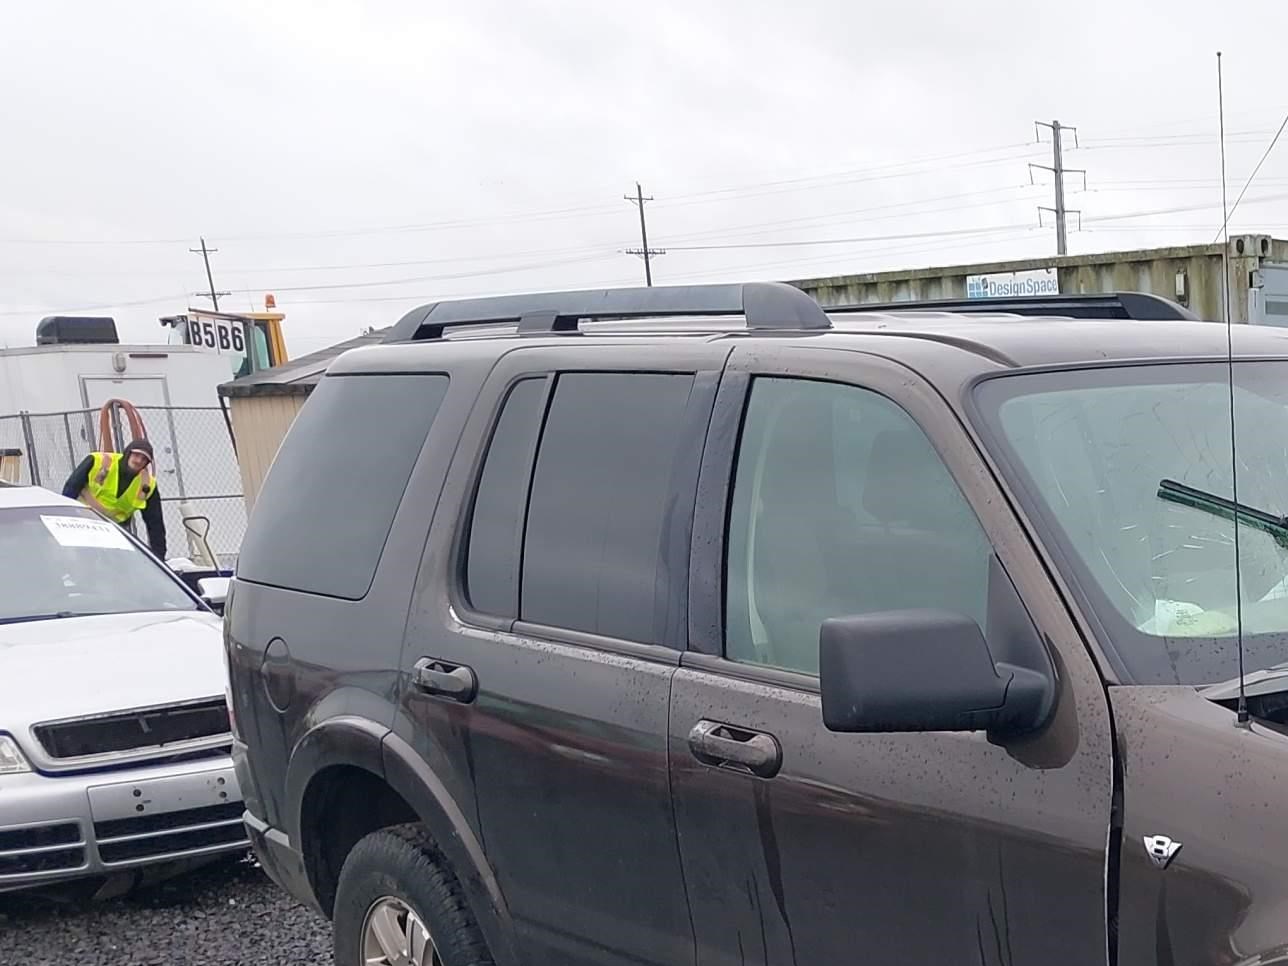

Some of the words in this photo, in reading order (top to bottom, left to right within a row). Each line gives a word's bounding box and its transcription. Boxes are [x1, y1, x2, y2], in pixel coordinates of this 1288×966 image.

[989, 278, 1057, 297] DesignSpace
[190, 320, 216, 349] B5
[217, 324, 245, 352] B6
